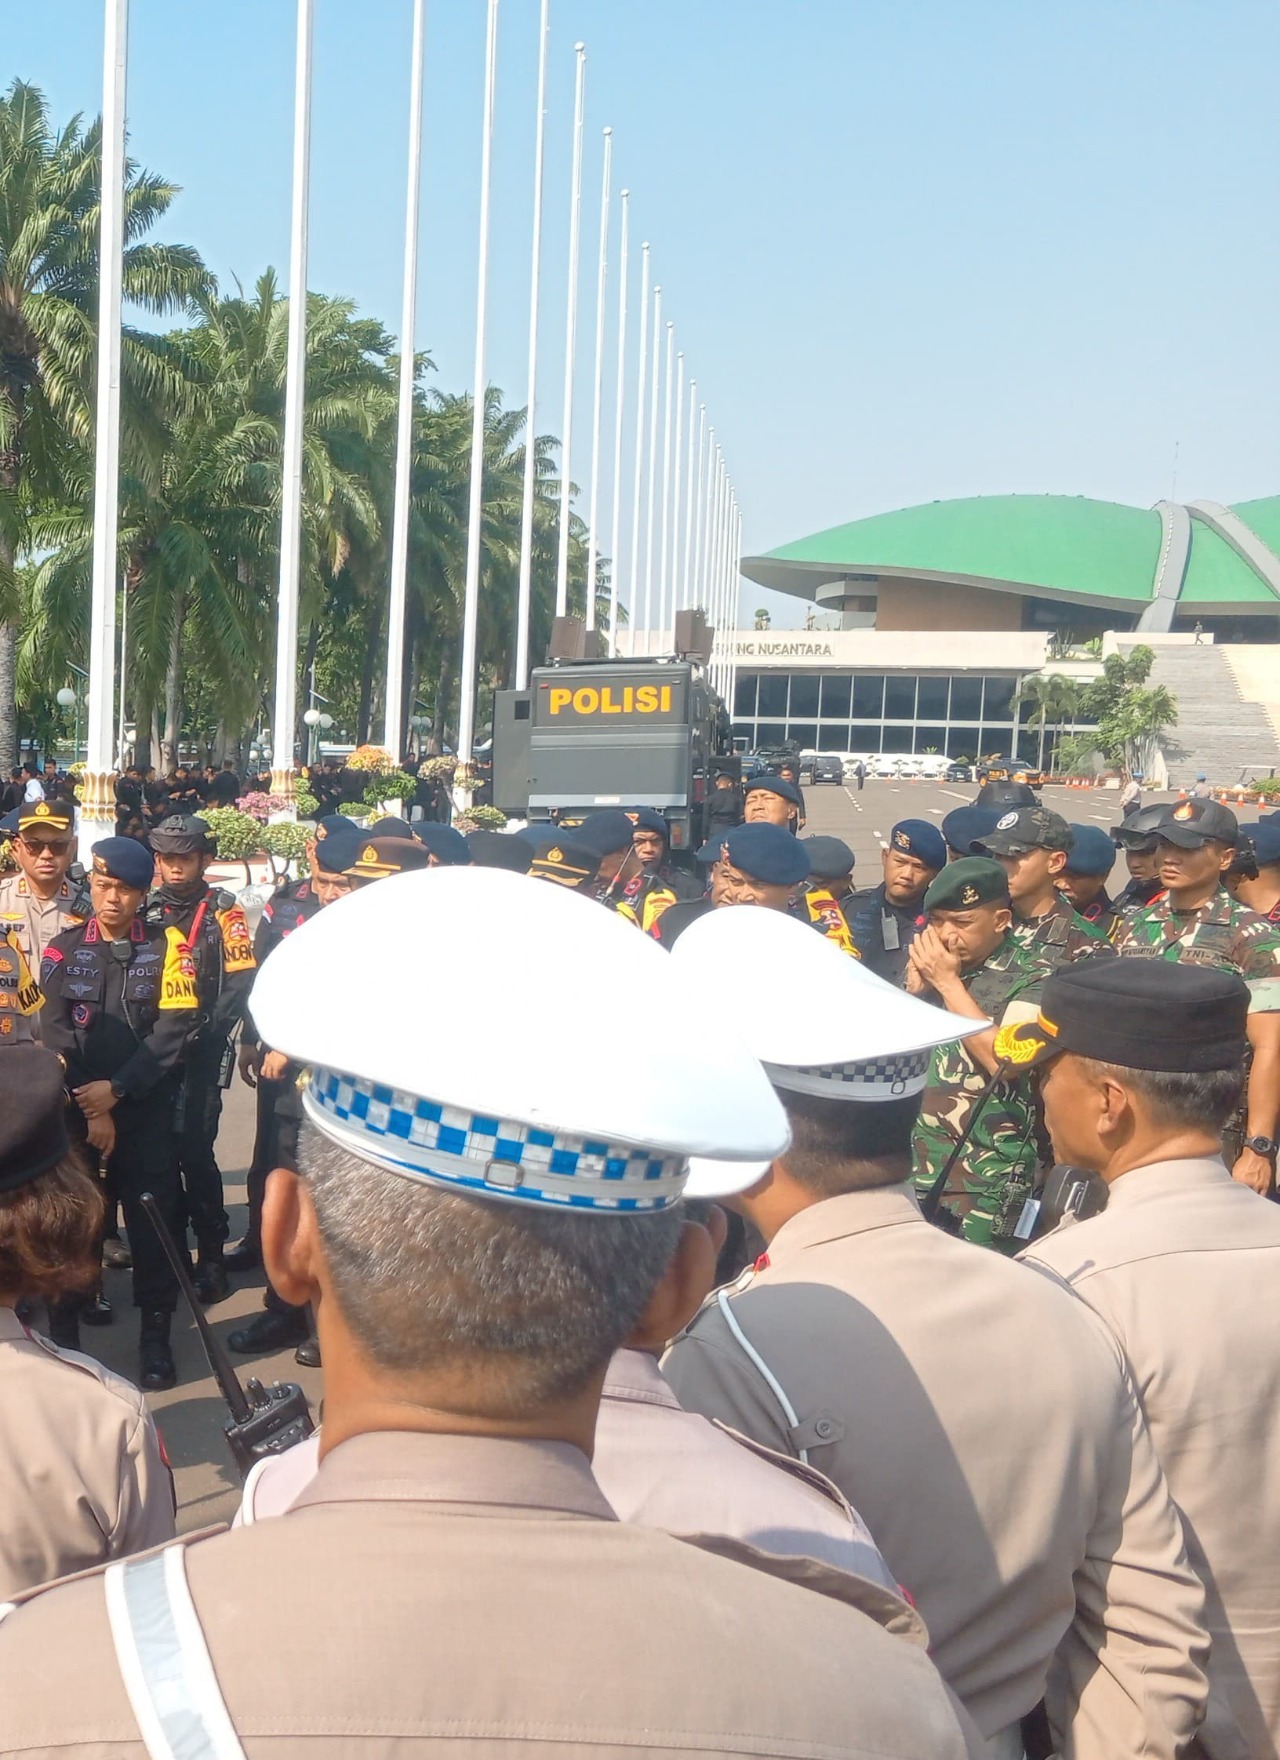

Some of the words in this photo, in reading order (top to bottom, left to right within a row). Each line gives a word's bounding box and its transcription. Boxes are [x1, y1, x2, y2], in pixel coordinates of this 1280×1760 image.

[758, 643, 831, 655] NUSANTARA
[550, 686, 671, 715] POLISI
[67, 967, 99, 977] ESTY
